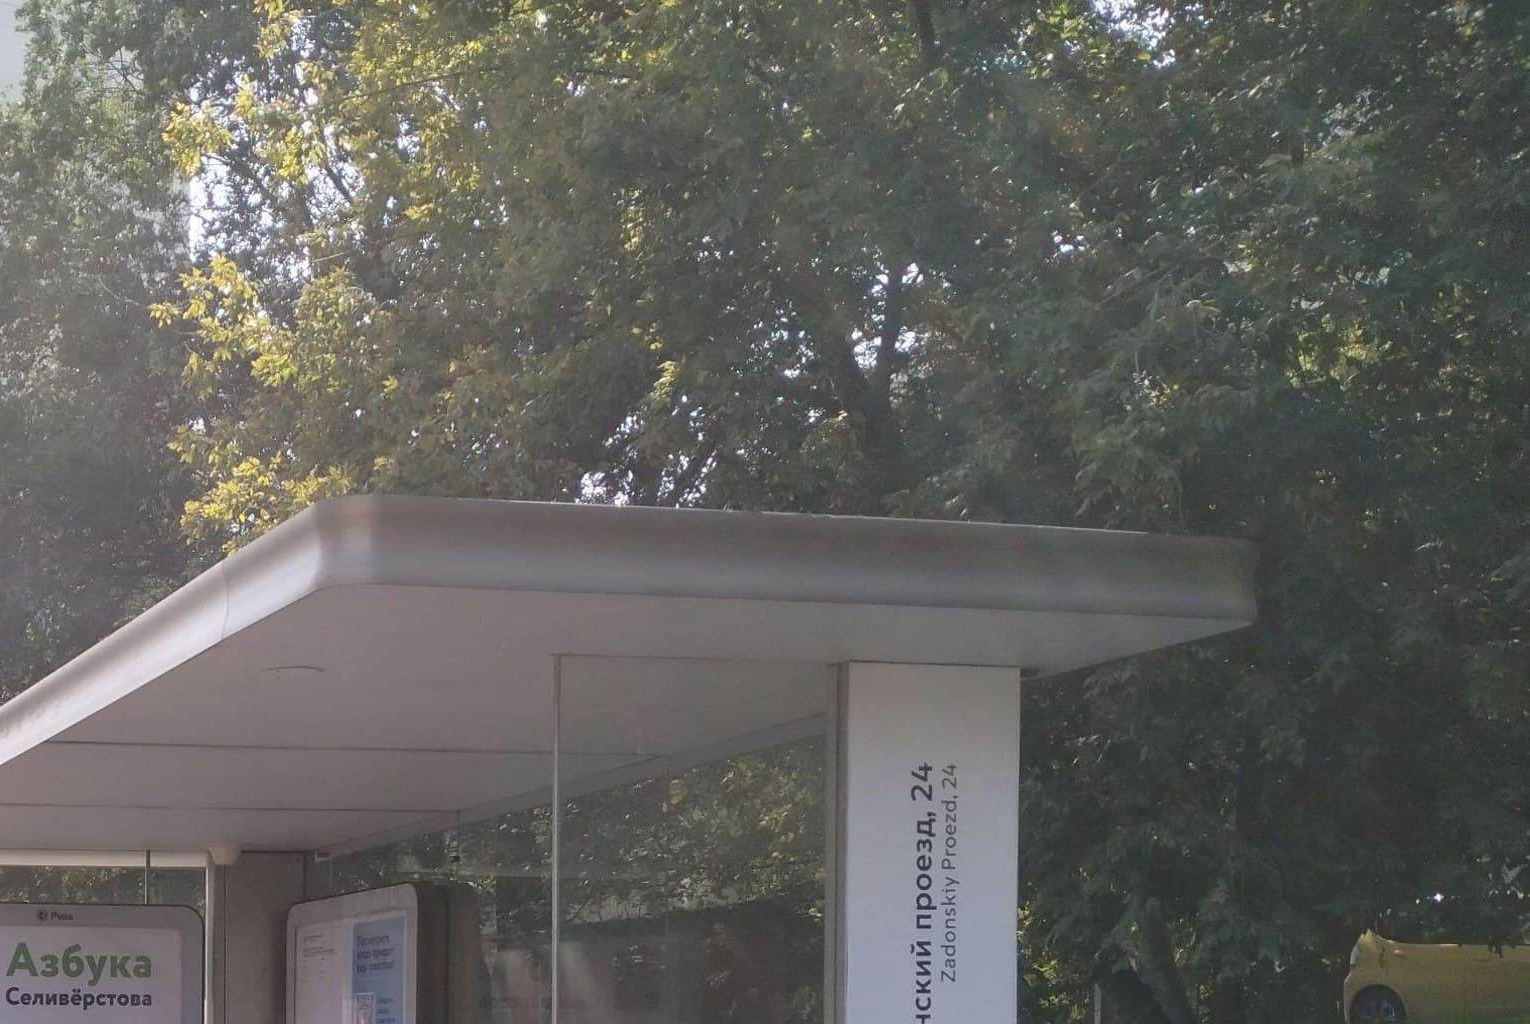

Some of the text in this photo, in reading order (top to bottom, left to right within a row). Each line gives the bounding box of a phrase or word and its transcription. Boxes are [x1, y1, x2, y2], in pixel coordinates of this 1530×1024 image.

[911, 762, 934, 801] 24
[915, 811, 938, 930] проезд,
[941, 764, 960, 983] Zadonskiy Proezd, 24
[5, 941, 152, 986] Азбука
[5, 987, 152, 1010] Селивёрстова
